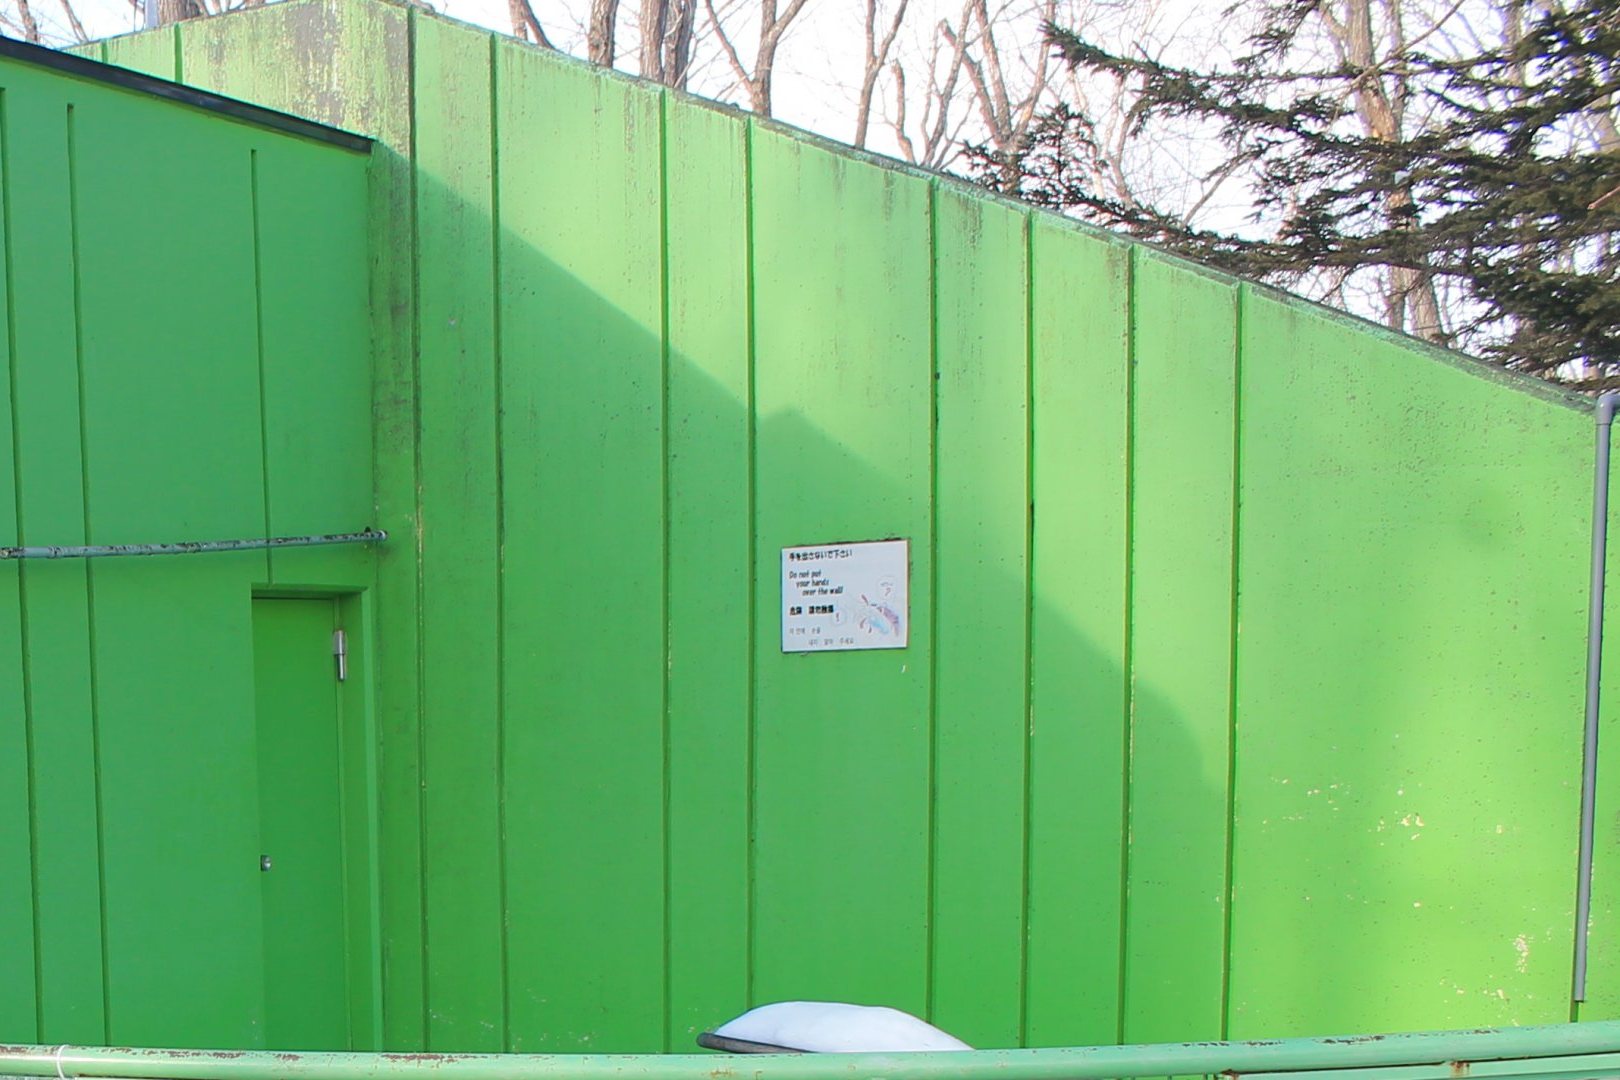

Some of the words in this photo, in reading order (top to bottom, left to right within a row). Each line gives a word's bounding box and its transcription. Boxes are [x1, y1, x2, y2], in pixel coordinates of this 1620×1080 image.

[789, 570, 797, 579] Do
[798, 569, 809, 579] not
[811, 569, 822, 579] put
[796, 580, 810, 589] your
[811, 578, 829, 587] hands
[818, 587, 828, 596] the
